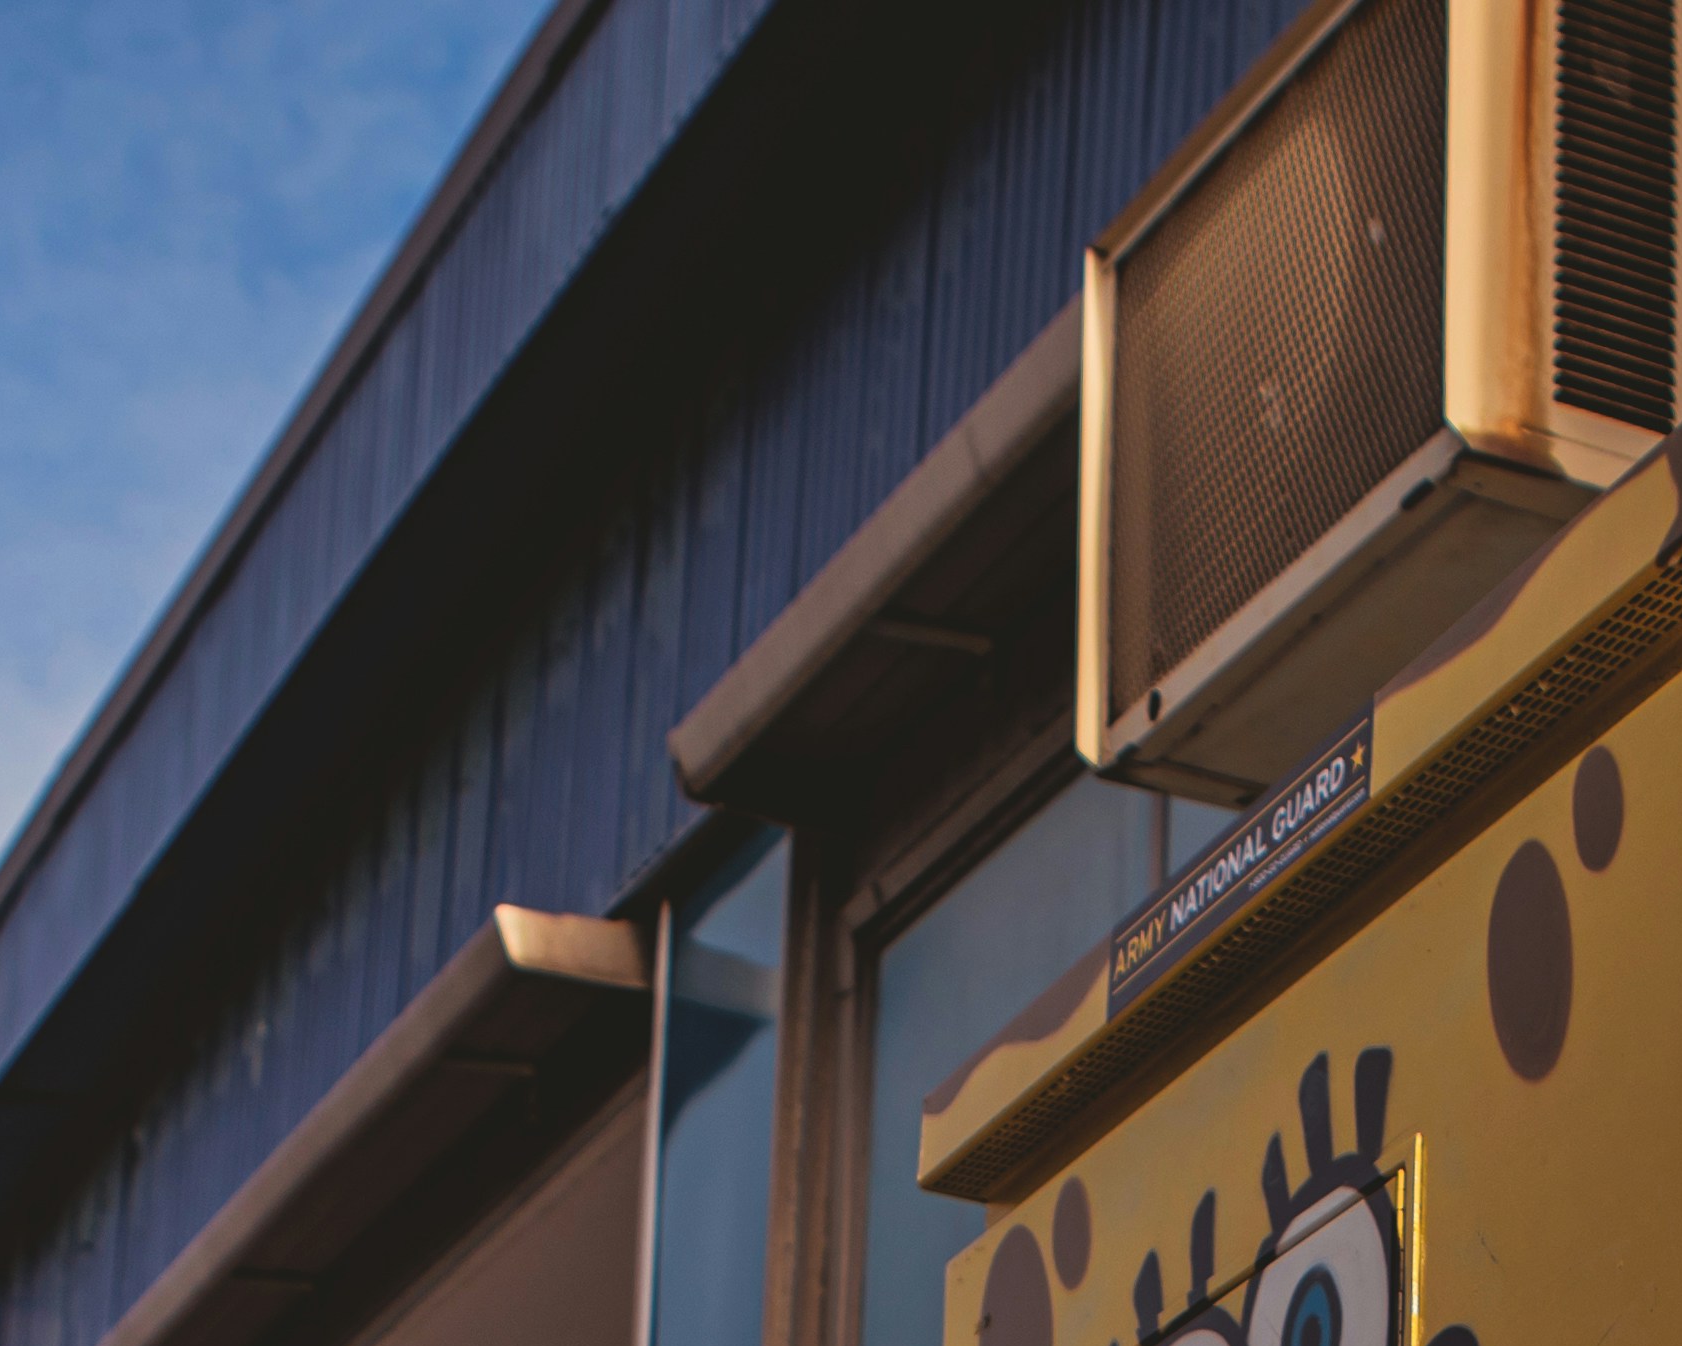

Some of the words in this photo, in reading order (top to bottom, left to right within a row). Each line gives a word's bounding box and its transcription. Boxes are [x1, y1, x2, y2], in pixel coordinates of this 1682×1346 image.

[1114, 909, 1168, 981] ARMY
[1169, 826, 1268, 931] NATIONAL
[1271, 756, 1346, 840] GUARD
